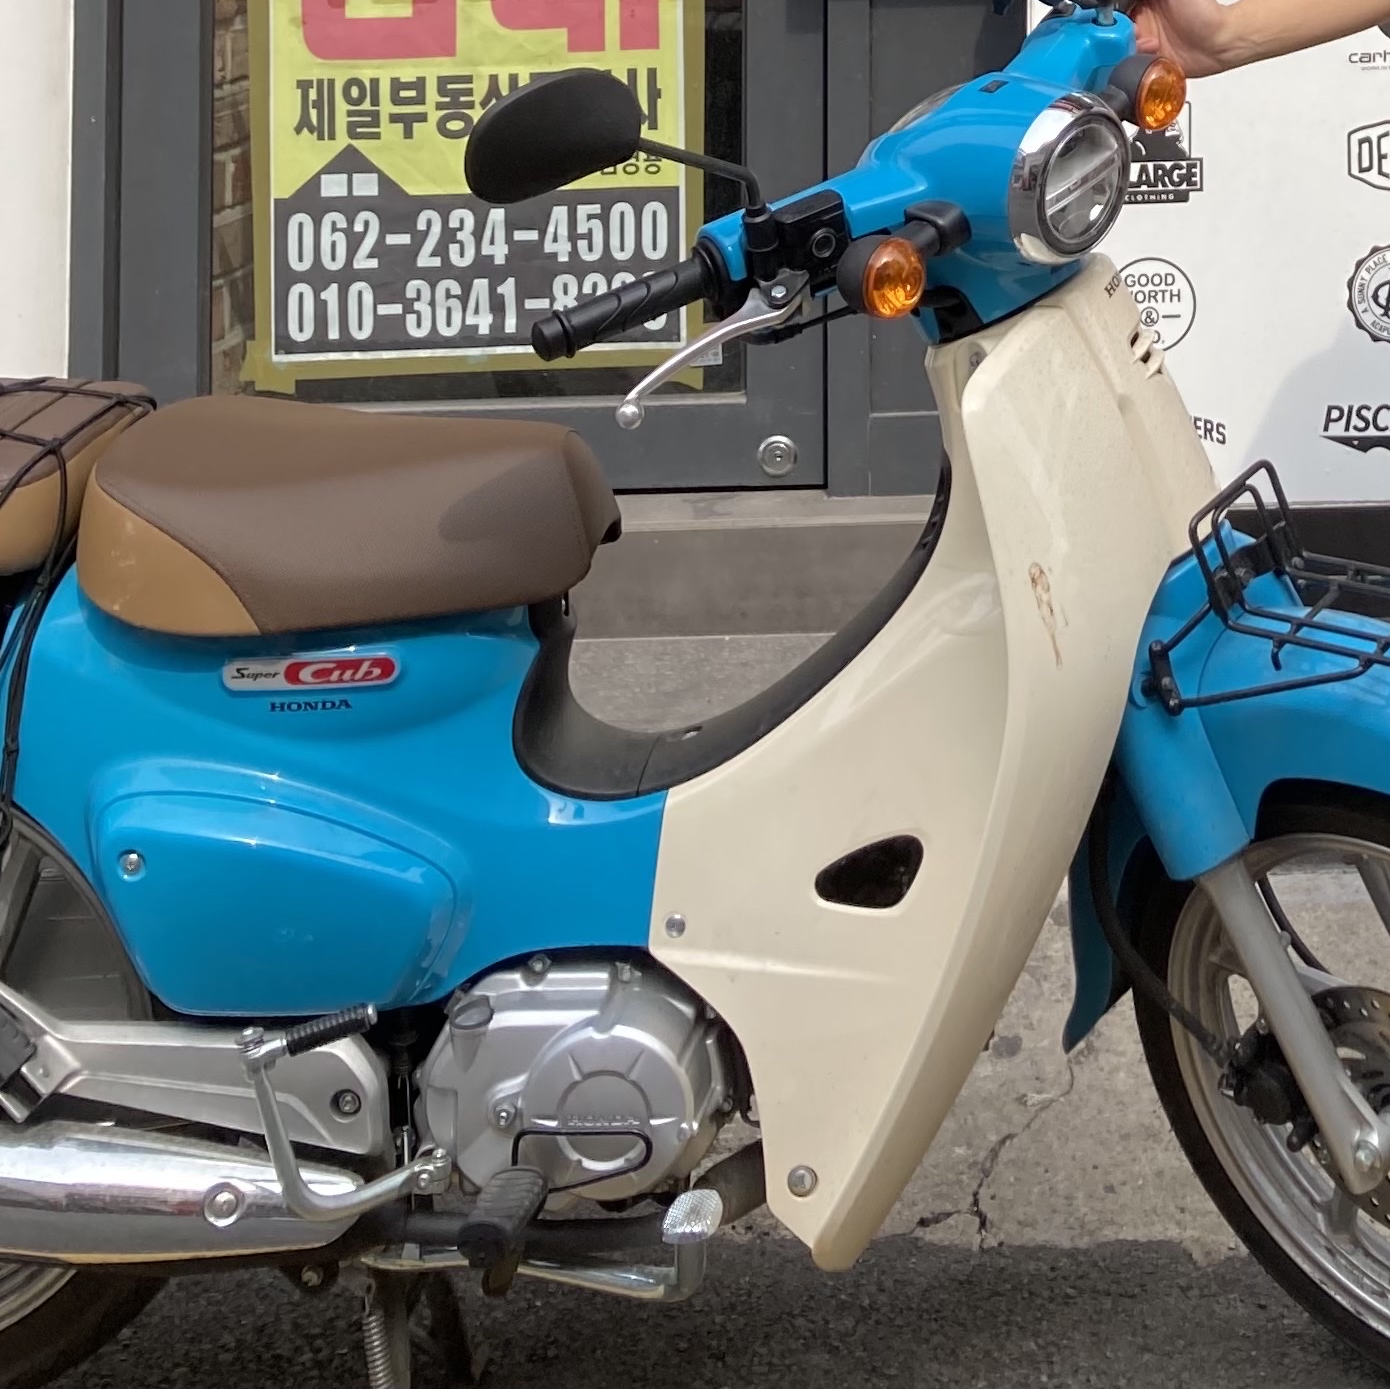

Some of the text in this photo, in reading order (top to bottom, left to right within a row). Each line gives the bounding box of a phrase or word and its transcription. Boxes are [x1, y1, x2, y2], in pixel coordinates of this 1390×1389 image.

[294, 68, 662, 141] 제일부동사
[1124, 193, 1175, 202] CLOTHING
[286, 202, 669, 271] 062-234-4500
[1124, 273, 1176, 288] GOOD
[1357, 275, 1368, 305] SUNNY
[1365, 253, 1389, 274] PLACE
[286, 271, 668, 343] 010-3641-8
[1130, 289, 1181, 304] ORTH
[1189, 415, 1227, 445] ERS
[231, 661, 382, 683] Super Cub
[270, 699, 353, 712] HONDA
